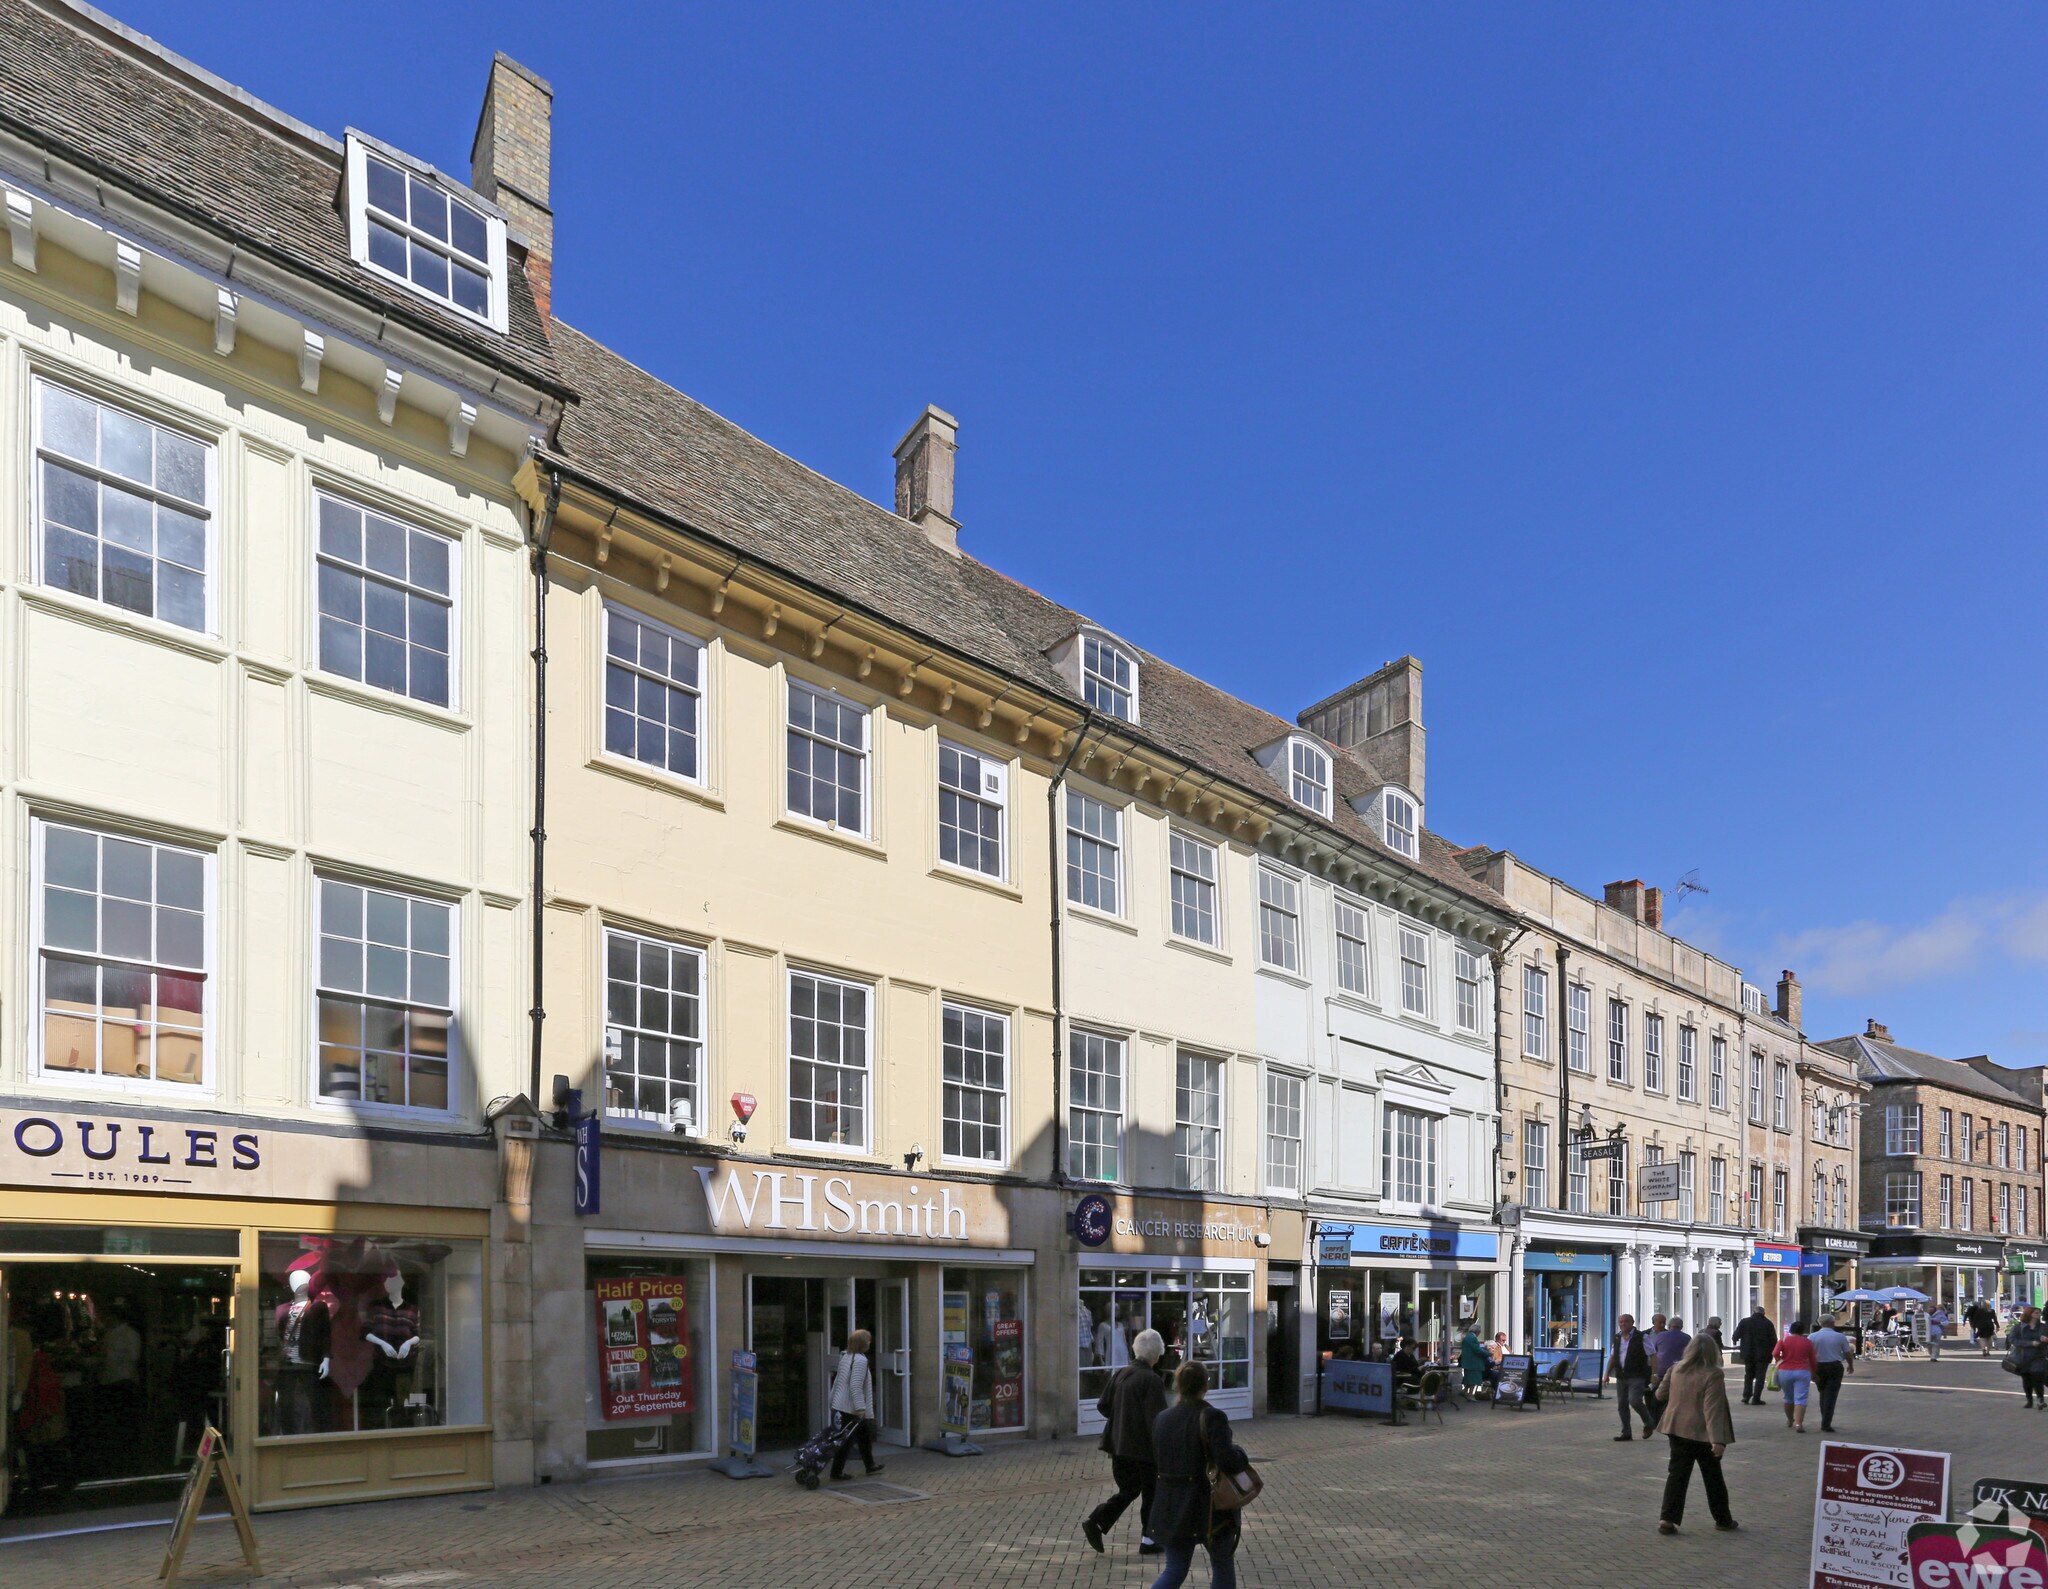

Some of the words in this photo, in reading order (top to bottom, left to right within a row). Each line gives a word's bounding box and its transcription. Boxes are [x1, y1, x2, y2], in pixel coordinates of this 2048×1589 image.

[13, 1117, 260, 1170] OULES
[1584, 1147, 1617, 1158] SEASALT
[88, 1172, 116, 1181] EST.
[124, 1173, 159, 1184] 1989
[576, 1145, 588, 1208] S
[692, 1166, 969, 1240] WHSmith
[1116, 1219, 1169, 1236] CANCER
[1174, 1223, 1234, 1240] RESEARCH
[1238, 1227, 1253, 1241] UK
[1320, 1252, 1348, 1260] NERO
[597, 1282, 634, 1298] Half
[640, 1281, 683, 1296] Price
[611, 1350, 634, 1360] VIETNA
[1333, 1381, 1382, 1397] NERO
[616, 1395, 634, 1403] Out
[638, 1391, 680, 1402] Thursday
[612, 1404, 631, 1414] 20th
[634, 1400, 686, 1412] September
[1869, 1459, 1894, 1474] 23
[1868, 1472, 1894, 1480] SEVEN
[1826, 1486, 1848, 1494] Men's
[1866, 1492, 1899, 1500] women's
[1901, 1495, 1936, 1506] clothing,
[1838, 1494, 1859, 1502] shoes
[1876, 1499, 1922, 1510] accessories
[1977, 1486, 2016, 1505] UK
[1881, 1509, 1910, 1528] Yumi
[1844, 1526, 1886, 1538] FARAH
[1879, 1562, 1901, 1570] SCOTT
[1825, 1576, 1842, 1584] The
[1919, 1560, 2043, 1589] ewe
